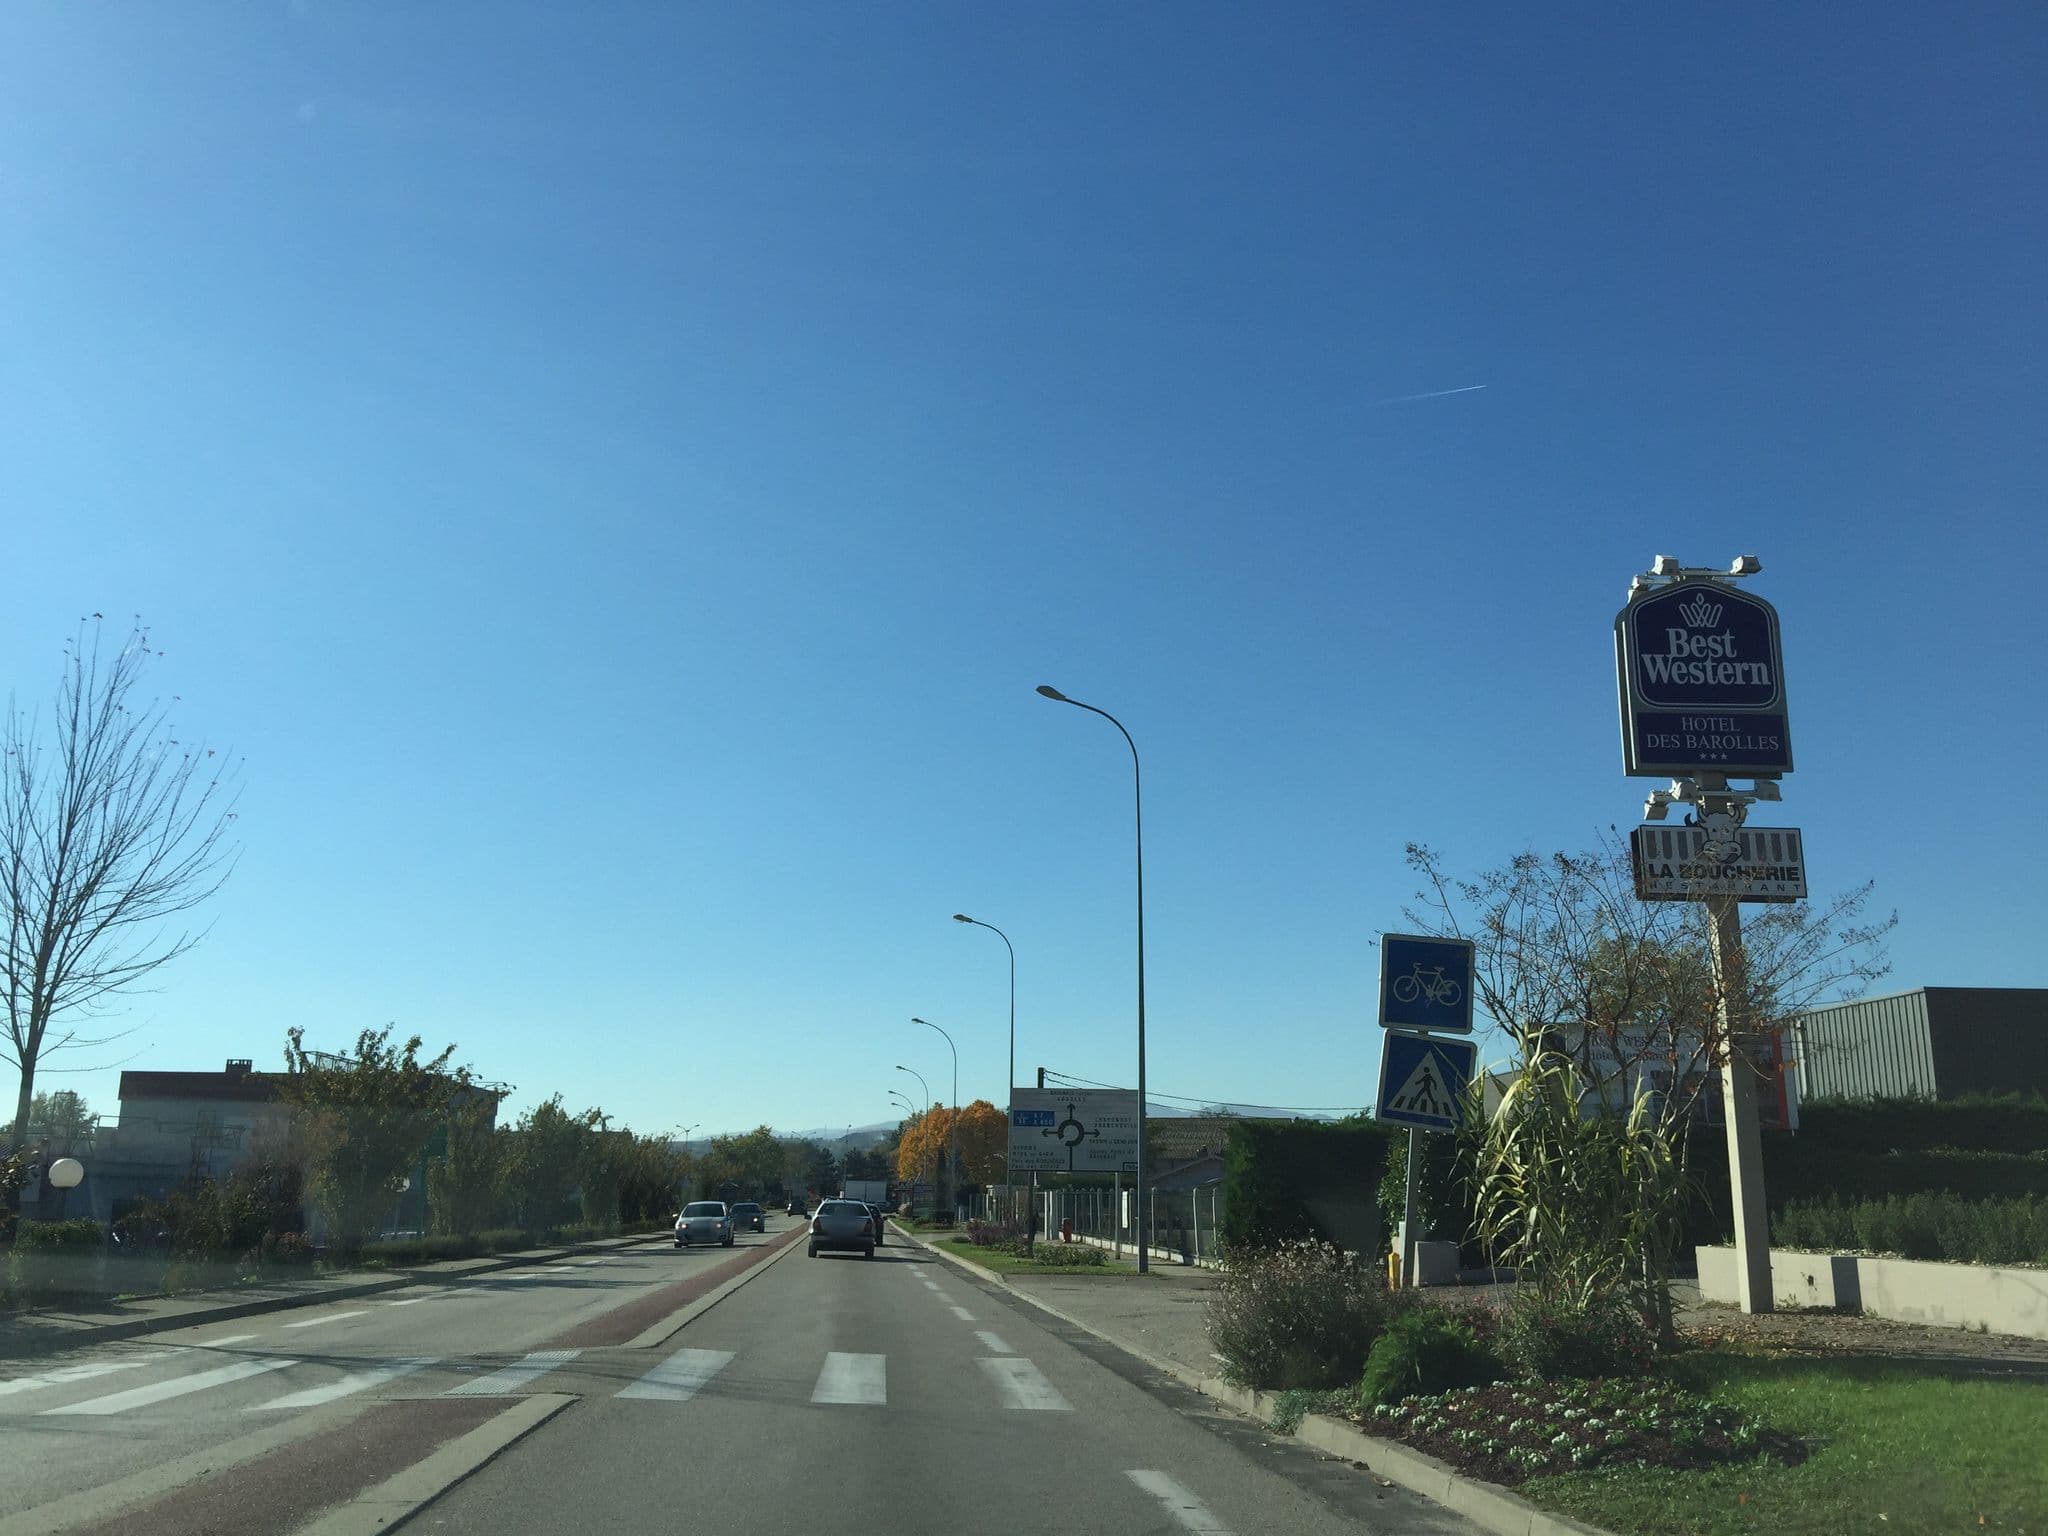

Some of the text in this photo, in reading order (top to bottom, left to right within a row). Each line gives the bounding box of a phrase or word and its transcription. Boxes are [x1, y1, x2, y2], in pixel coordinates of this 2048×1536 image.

[1666, 628, 1737, 658] Best
[1641, 649, 1771, 685] Western
[1681, 717, 1741, 732] HOTEL
[1646, 734, 1780, 750] DES BAROLLES
[1648, 863, 1675, 879] LA
